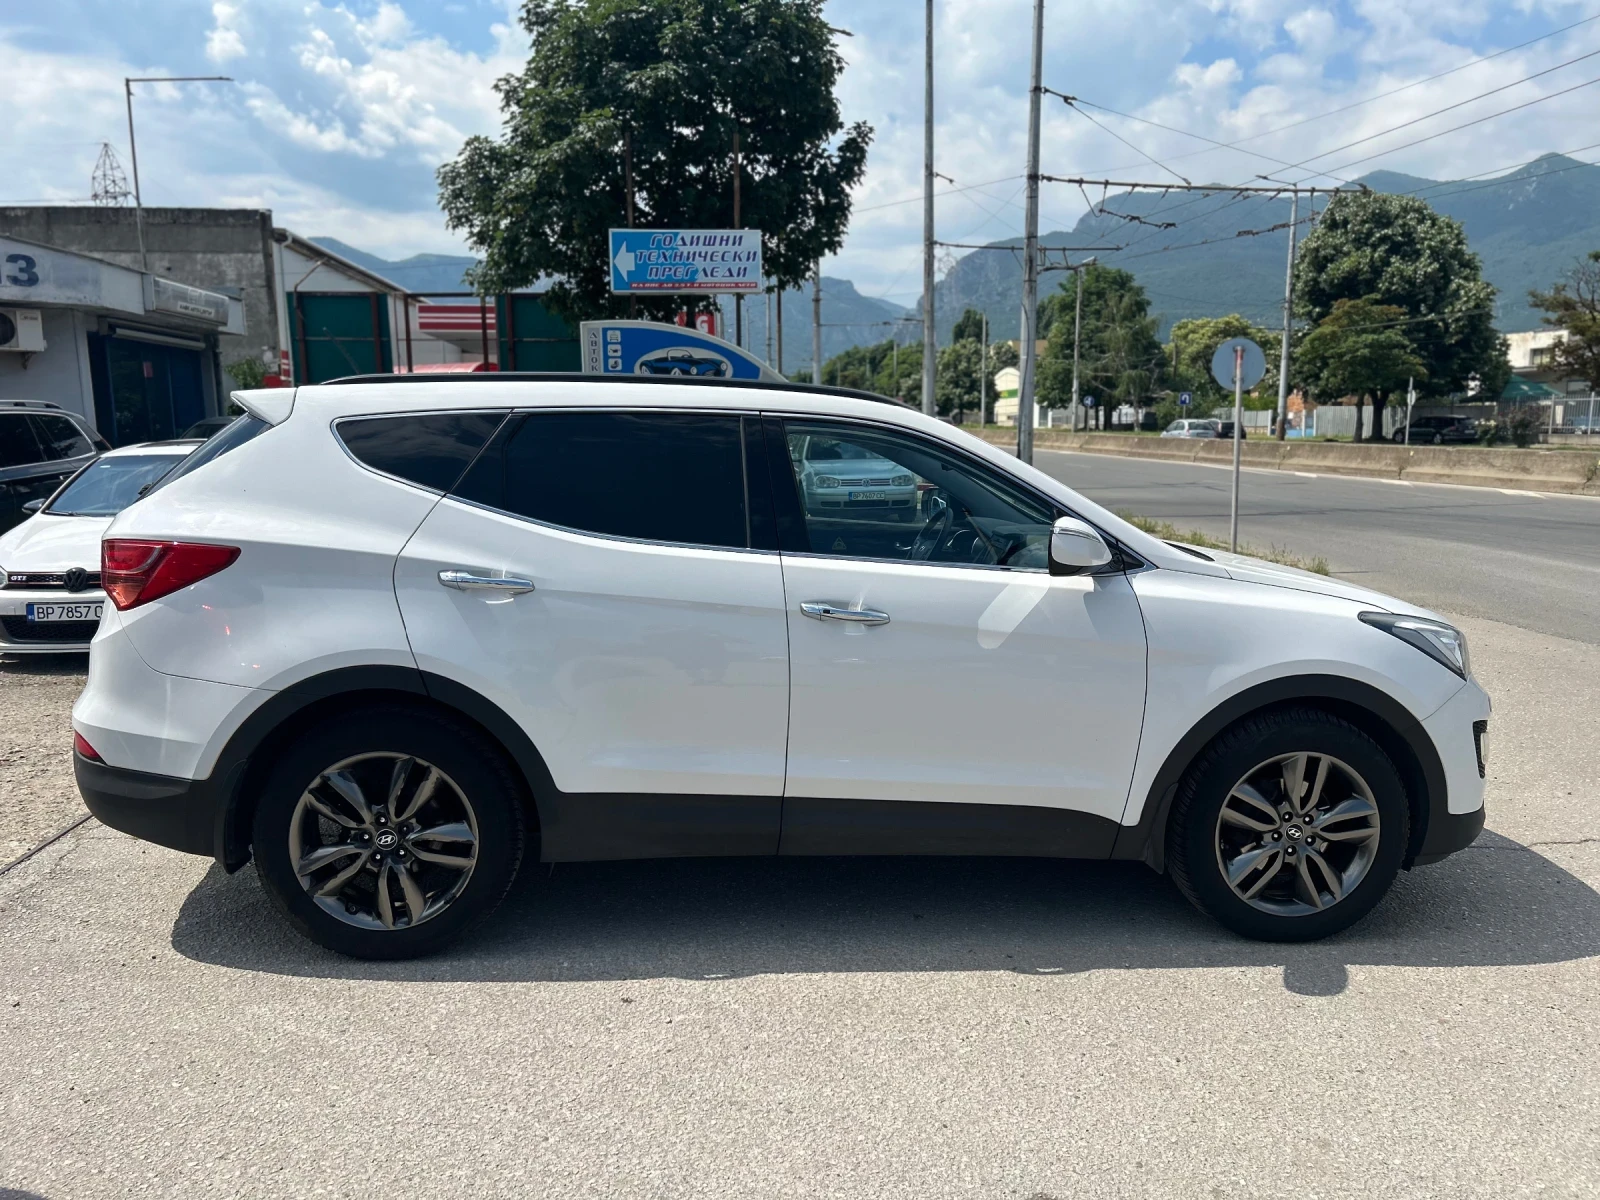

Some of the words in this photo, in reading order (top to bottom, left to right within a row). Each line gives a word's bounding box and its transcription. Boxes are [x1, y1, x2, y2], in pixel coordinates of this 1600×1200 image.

[650, 234, 744, 247] ГОДИШНИ
[636, 250, 757, 263] ТЕХНИЧЕСКИ
[0, 253, 39, 287] 3
[647, 265, 748, 279] ПРЕГЛЕДИ
[36, 606, 54, 619] BP
[57, 605, 91, 619] 7857
